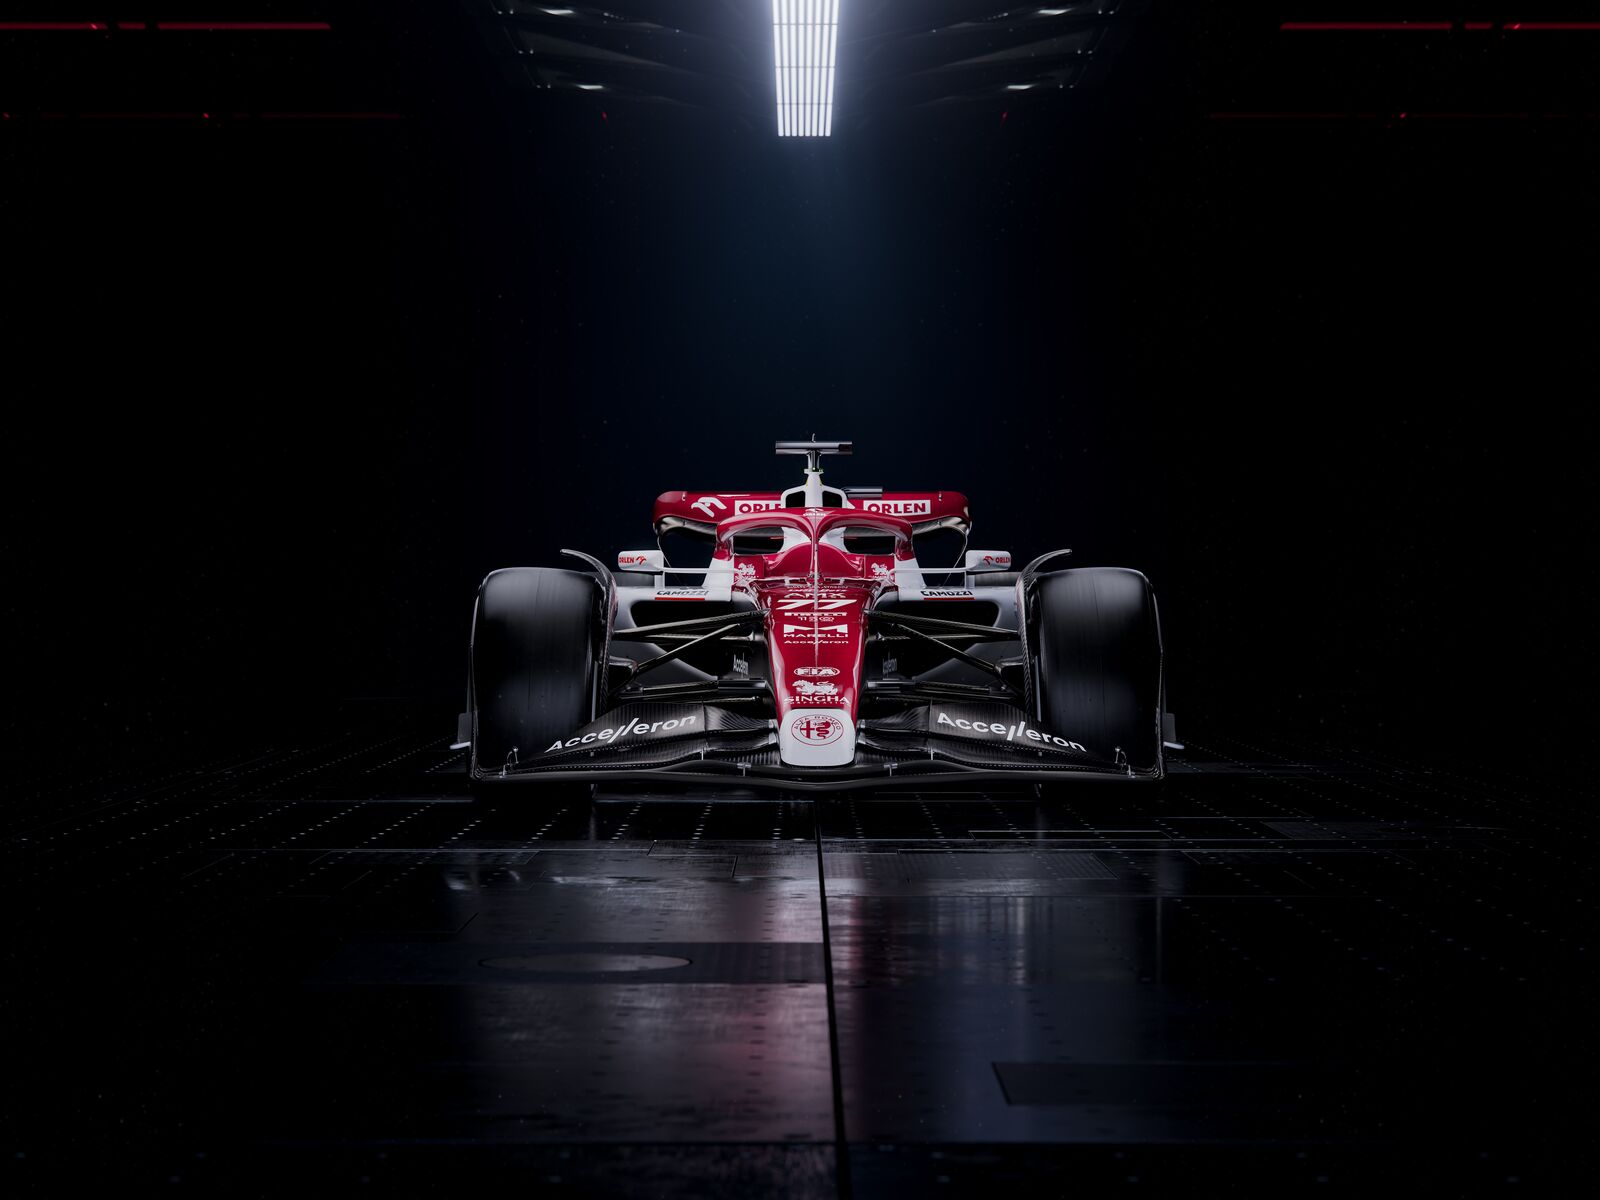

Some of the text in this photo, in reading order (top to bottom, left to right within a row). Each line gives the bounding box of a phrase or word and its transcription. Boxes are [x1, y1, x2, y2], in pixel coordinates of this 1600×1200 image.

[867, 503, 926, 514] ORLEN
[776, 599, 857, 610] 77
[798, 668, 835, 676] FIA
[544, 717, 696, 753] Accelleron
[937, 712, 1087, 752] Accelleron
